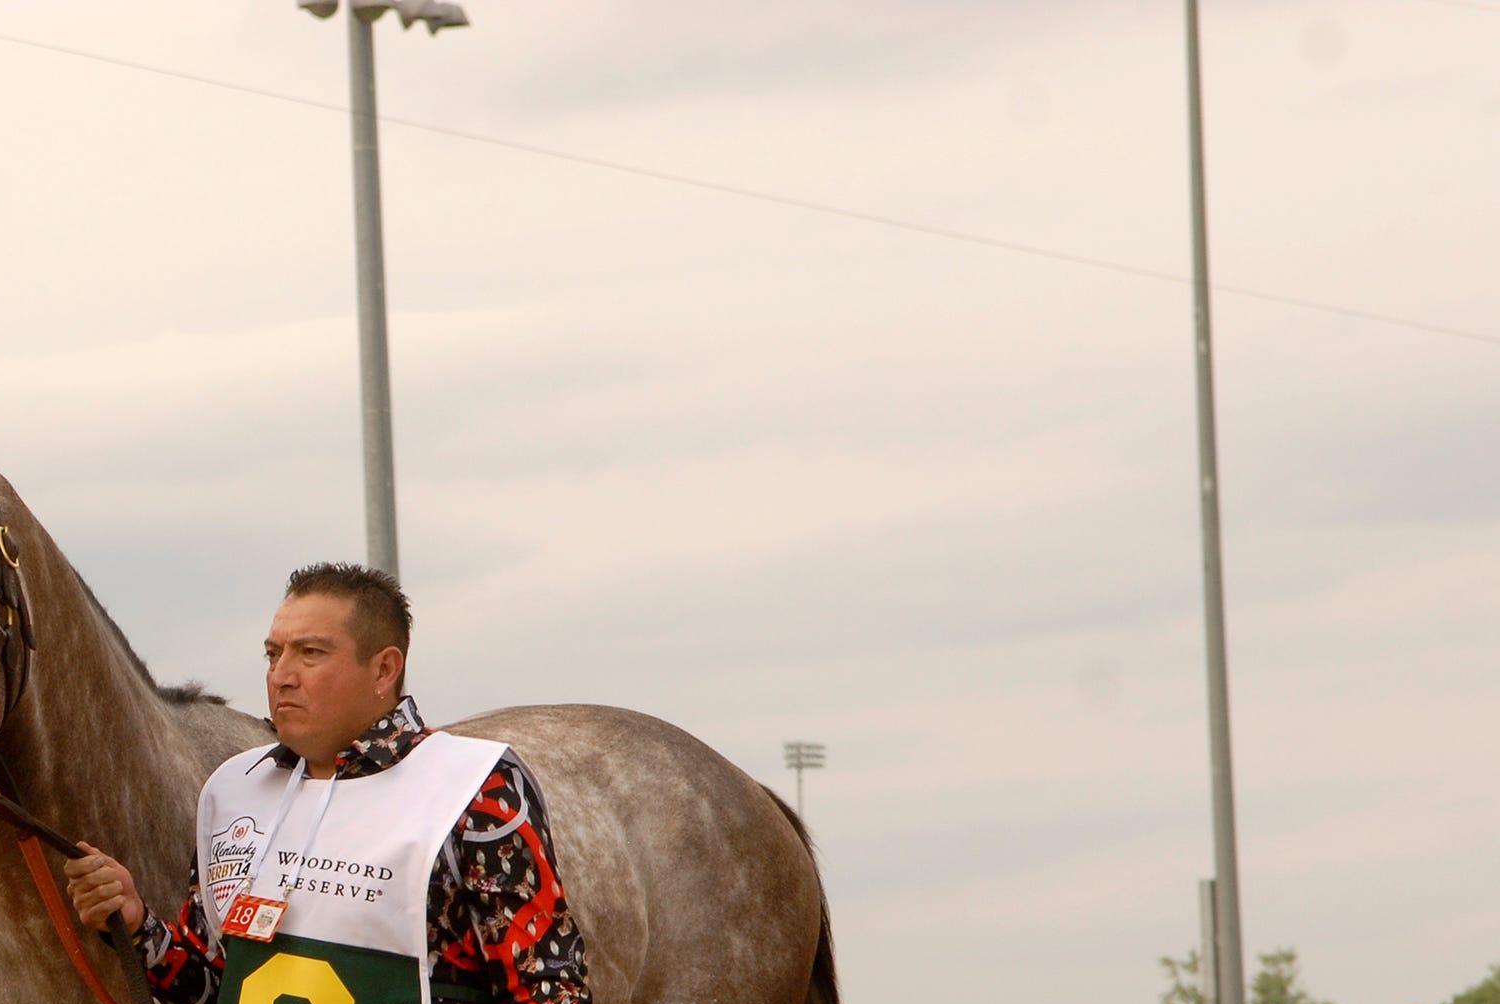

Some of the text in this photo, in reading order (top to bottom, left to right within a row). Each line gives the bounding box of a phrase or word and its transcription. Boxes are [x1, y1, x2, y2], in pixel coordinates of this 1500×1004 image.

[212, 841, 257, 863] Kentucky
[207, 862, 252, 883] DERBY14
[230, 905, 254, 925] 18
